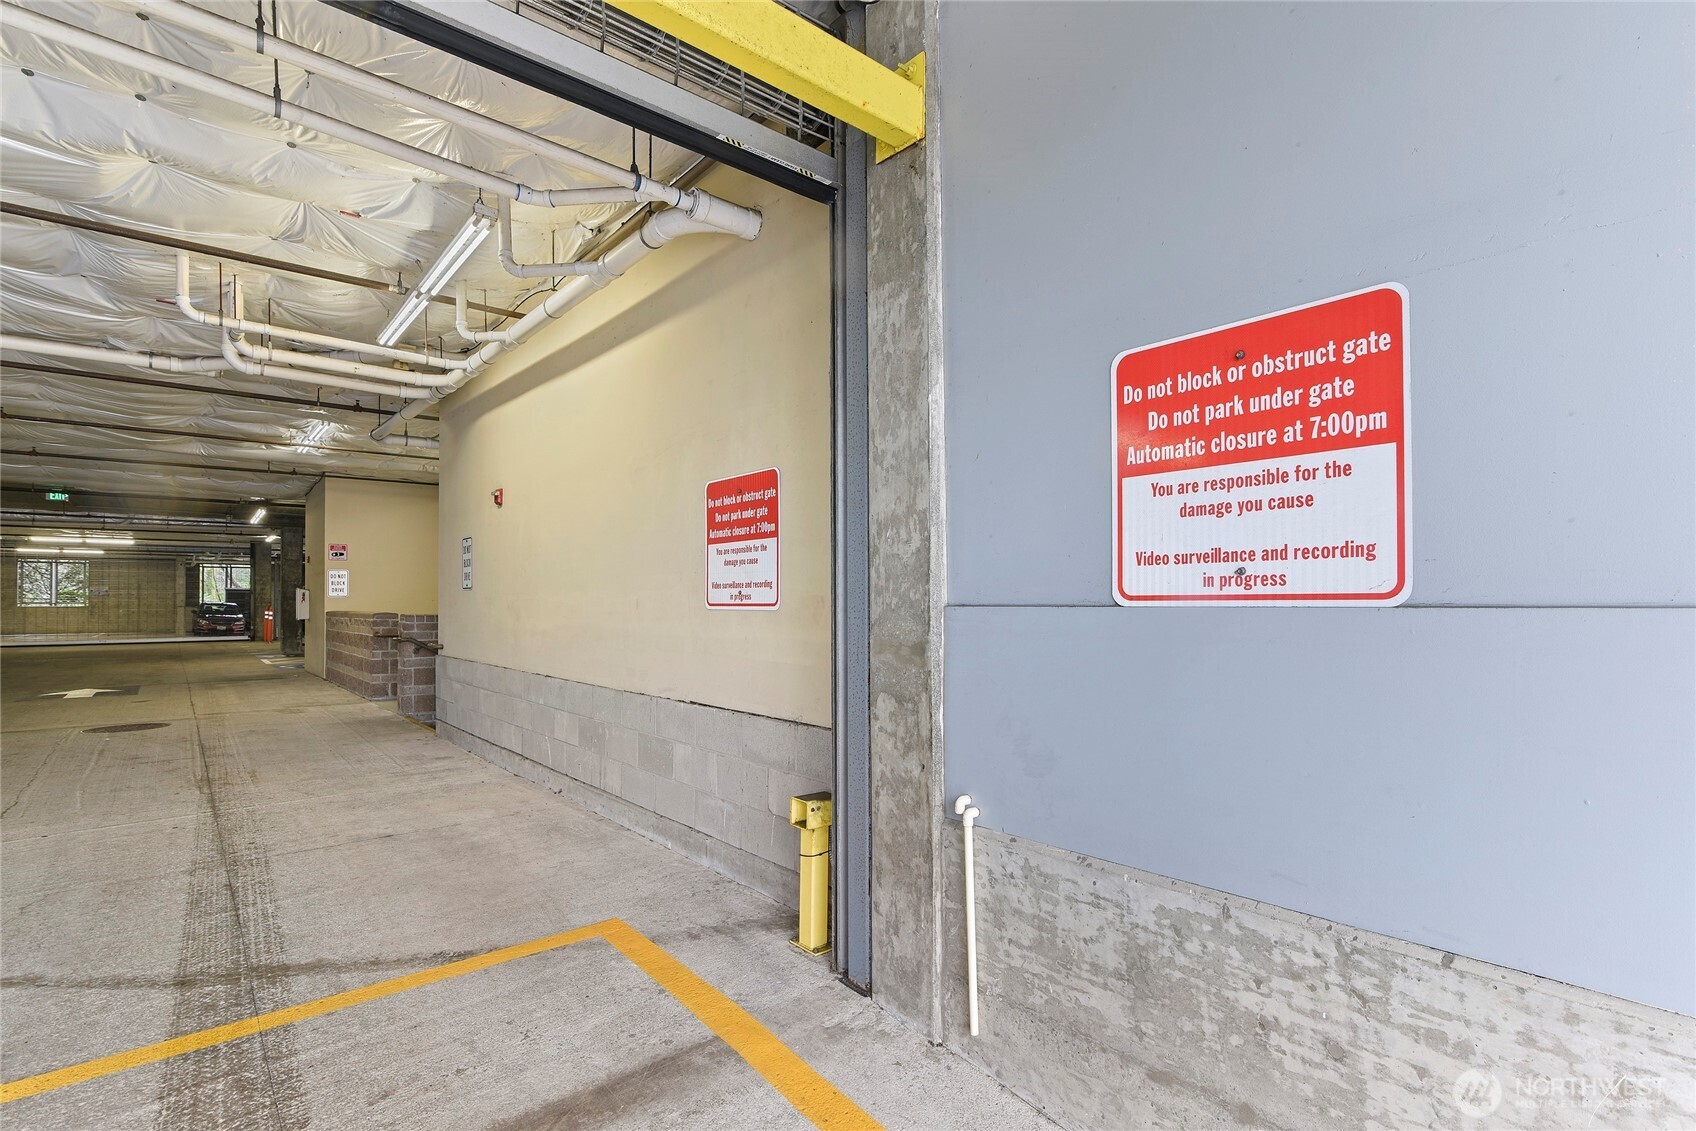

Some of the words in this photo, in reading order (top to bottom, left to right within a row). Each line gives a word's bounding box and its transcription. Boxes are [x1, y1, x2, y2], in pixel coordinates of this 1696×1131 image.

[1123, 385, 1142, 405] Do
[1147, 377, 1172, 400] not
[1178, 365, 1222, 394] block
[1227, 364, 1246, 383] or
[1252, 340, 1336, 378] obstruct
[1342, 331, 1391, 364] gate
[1148, 411, 1168, 431] Do
[1173, 404, 1199, 427] not
[1205, 395, 1244, 426] park
[1249, 386, 1303, 414] under
[1308, 376, 1355, 407] gate
[1126, 436, 1205, 466] Automatic
[1210, 428, 1277, 454] closure
[1283, 420, 1303, 443] at
[1309, 410, 1387, 439] 7:00pm
[1151, 482, 1173, 498] You
[1177, 481, 1199, 495] are
[1203, 467, 1289, 493] responsible
[1294, 464, 1319, 482] for
[1324, 460, 1352, 479] the
[708, 499, 714, 508] Do
[723, 494, 735, 505] block
[736, 495, 741, 503] or
[742, 489, 763, 501] obstruct
[764, 487, 776, 500] gate
[1179, 502, 1232, 518] damage
[1237, 499, 1263, 517] you
[1267, 494, 1314, 511] cause
[715, 513, 721, 522] Do
[722, 512, 730, 521] not
[731, 509, 741, 522] park
[742, 508, 755, 518] under
[757, 506, 768, 518] gate
[709, 527, 731, 538] Automatic
[732, 526, 749, 536] closure
[750, 524, 755, 534] at
[757, 522, 775, 534] 7:00pm
[730, 545, 752, 555] responsible
[1135, 551, 1170, 567] Video
[1173, 547, 1257, 565] surveillance
[1261, 544, 1289, 562] and
[1293, 540, 1377, 562] recording
[724, 559, 738, 567] damage
[722, 580, 744, 589] surveillance
[753, 580, 772, 589] recording
[1202, 572, 1215, 588] in
[1219, 573, 1288, 591] progress
[734, 594, 751, 602] progress
